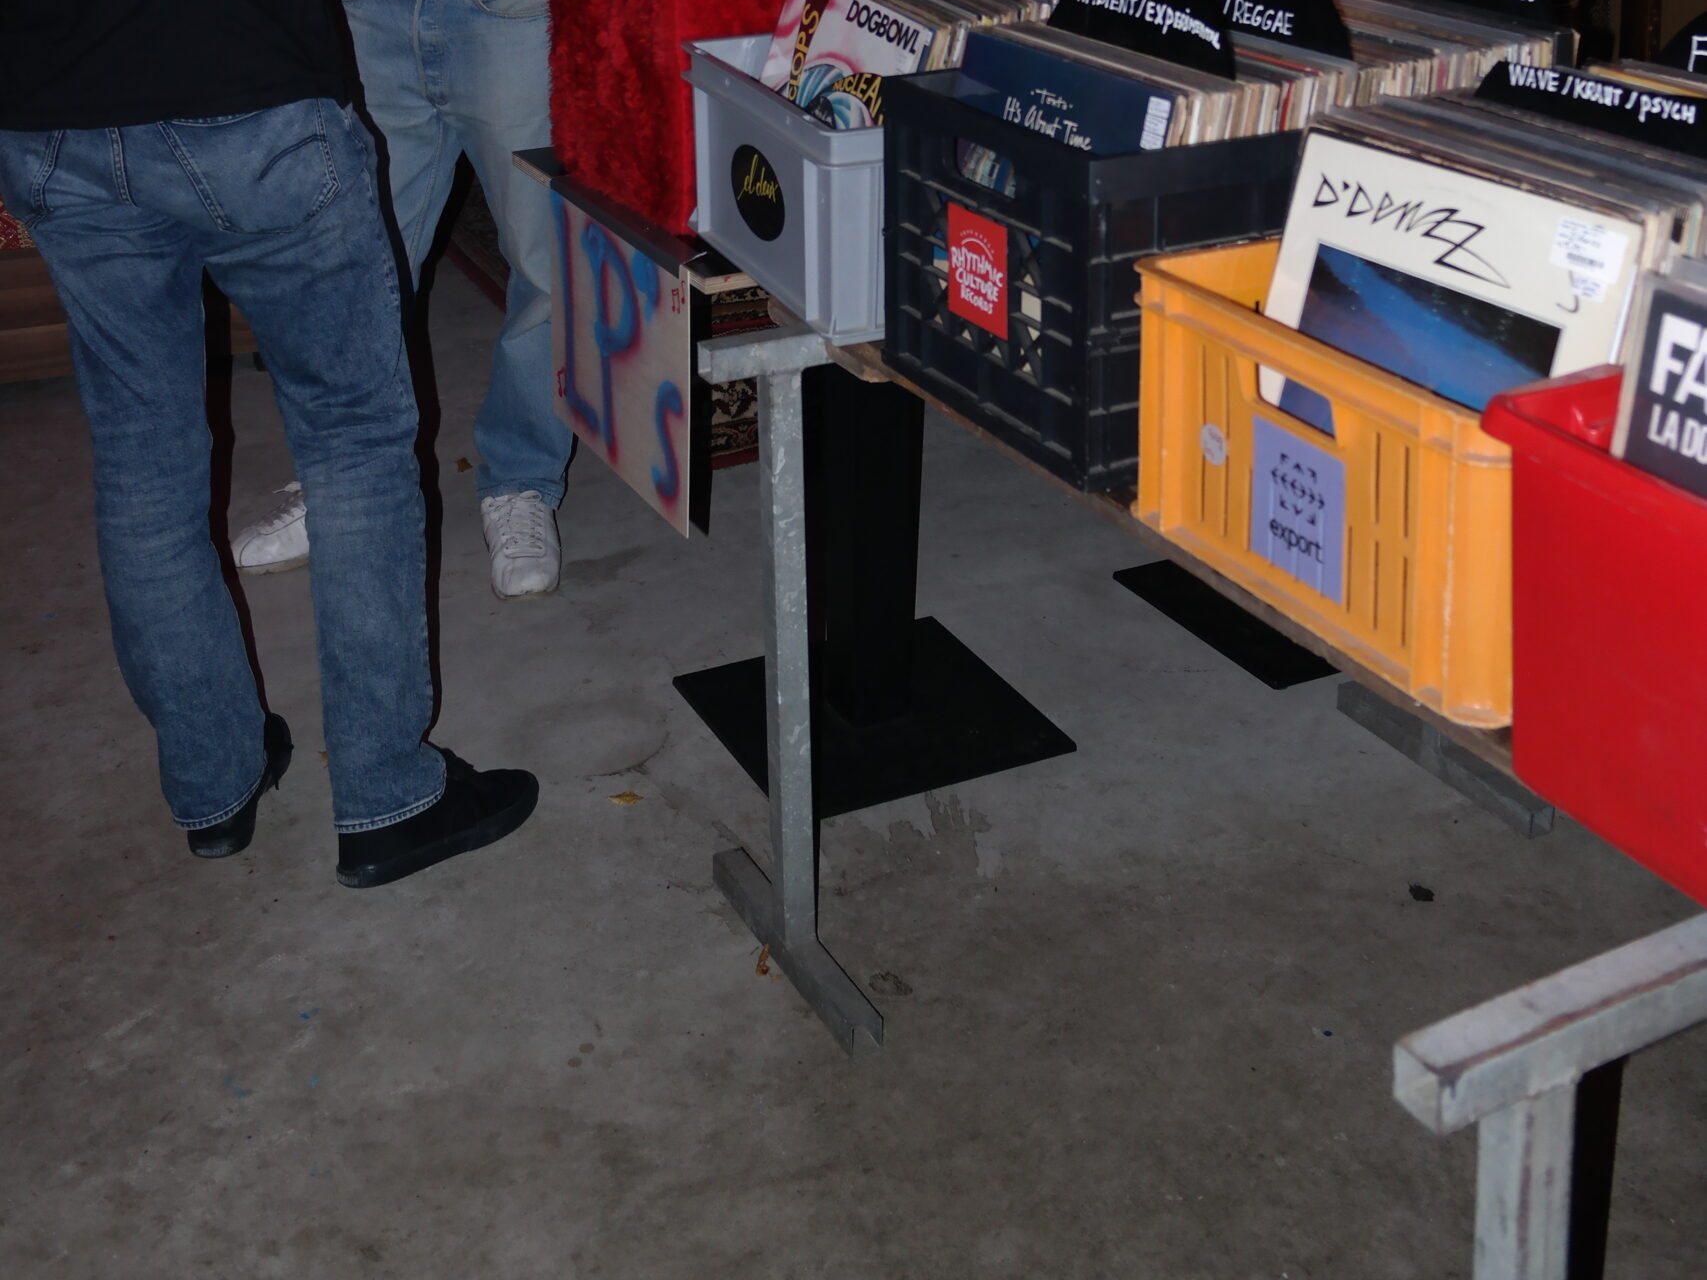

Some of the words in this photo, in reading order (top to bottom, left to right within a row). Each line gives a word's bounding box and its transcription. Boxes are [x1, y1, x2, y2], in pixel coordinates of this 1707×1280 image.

[846, 0, 920, 55] DOGBOWL
[1508, 64, 1559, 94] WAVE
[1063, 119, 1093, 151] Time
[951, 245, 1003, 288] RHYTHMIC
[955, 268, 999, 302] CULTURE
[960, 285, 993, 315] RECORDS
[1269, 518, 1324, 565] export
